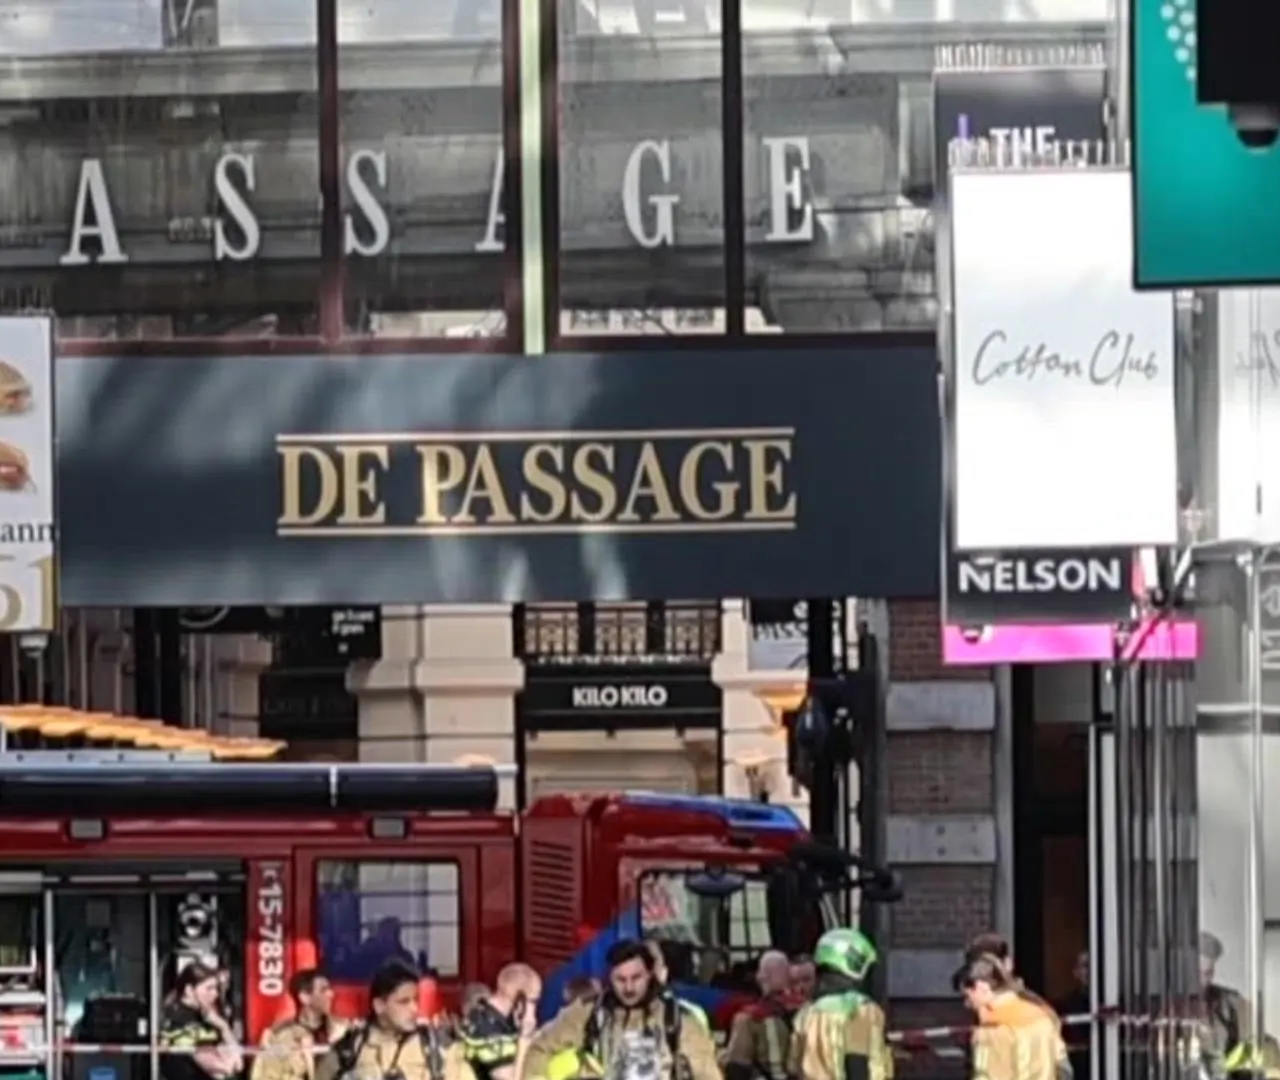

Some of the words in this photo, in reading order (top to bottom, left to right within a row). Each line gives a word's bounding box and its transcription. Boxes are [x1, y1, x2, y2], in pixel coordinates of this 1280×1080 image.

[972, 329, 1083, 386] Cotton
[1088, 329, 1160, 388] Club
[277, 443, 388, 526] DE
[414, 438, 798, 526] PASSAGE
[958, 558, 1121, 593] NELSON
[573, 686, 618, 707] KILO
[620, 685, 668, 707] KILO
